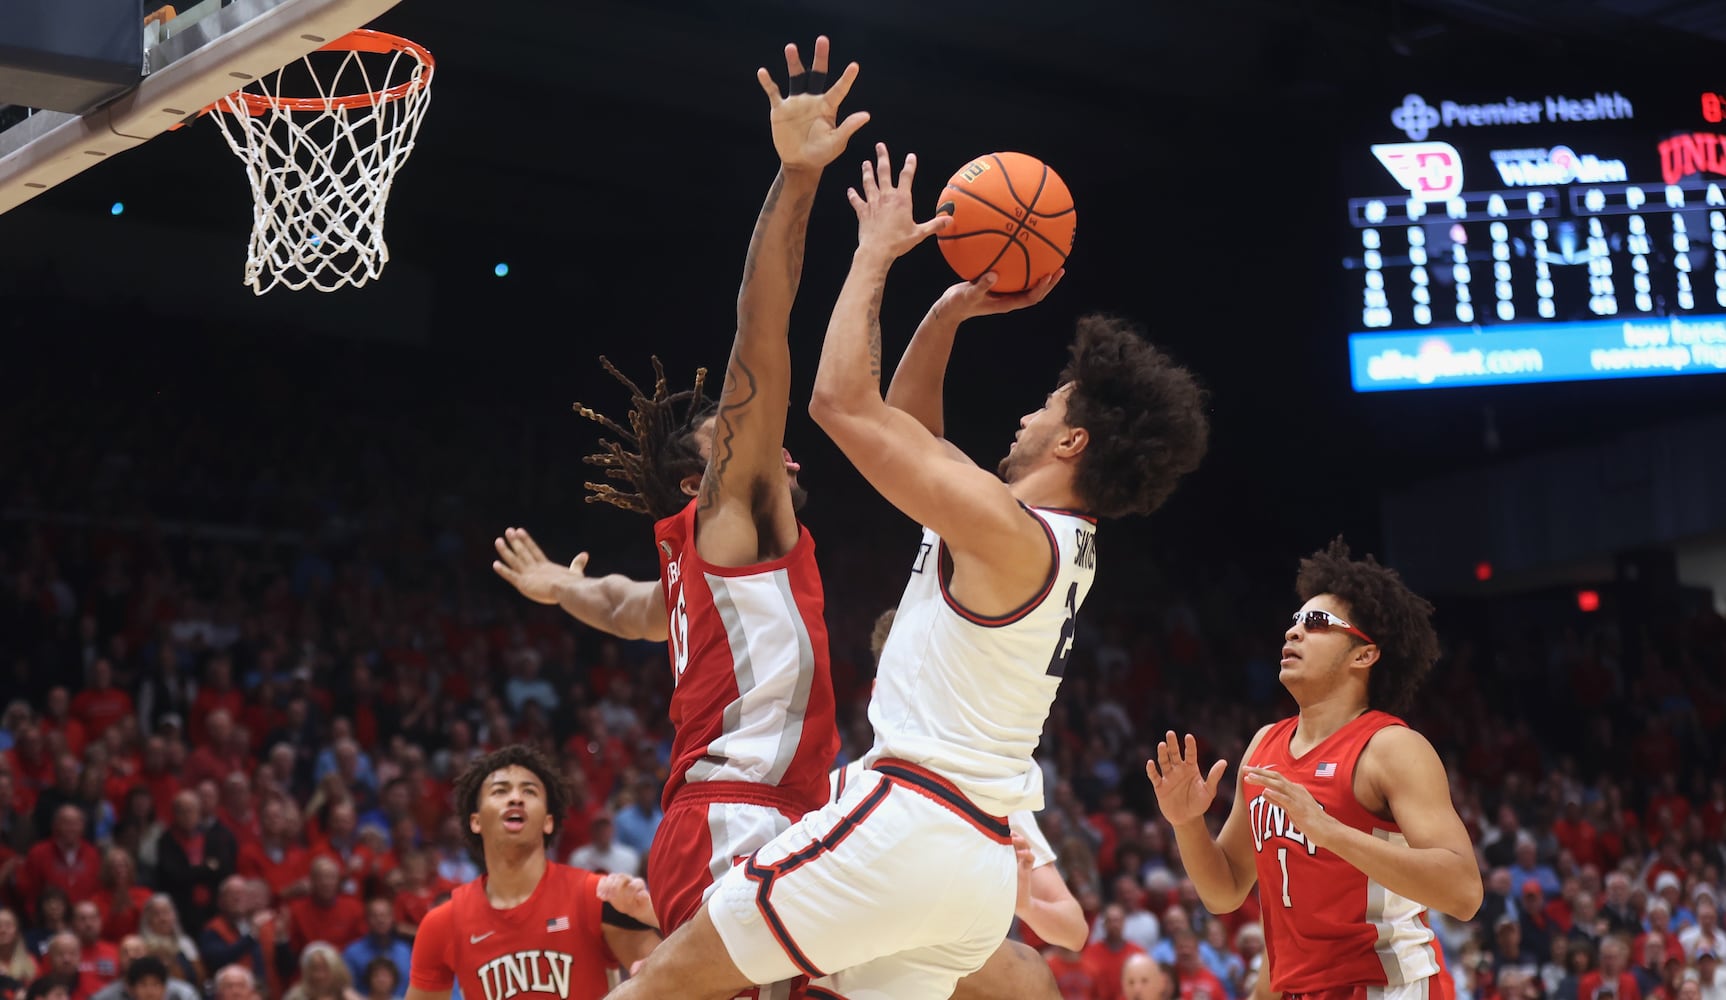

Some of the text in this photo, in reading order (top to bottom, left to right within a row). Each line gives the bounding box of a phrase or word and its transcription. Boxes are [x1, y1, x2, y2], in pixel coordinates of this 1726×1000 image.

[1441, 91, 1633, 127] Premier Health
[1277, 848, 1293, 908] 1
[477, 949, 574, 1000] UNLV
